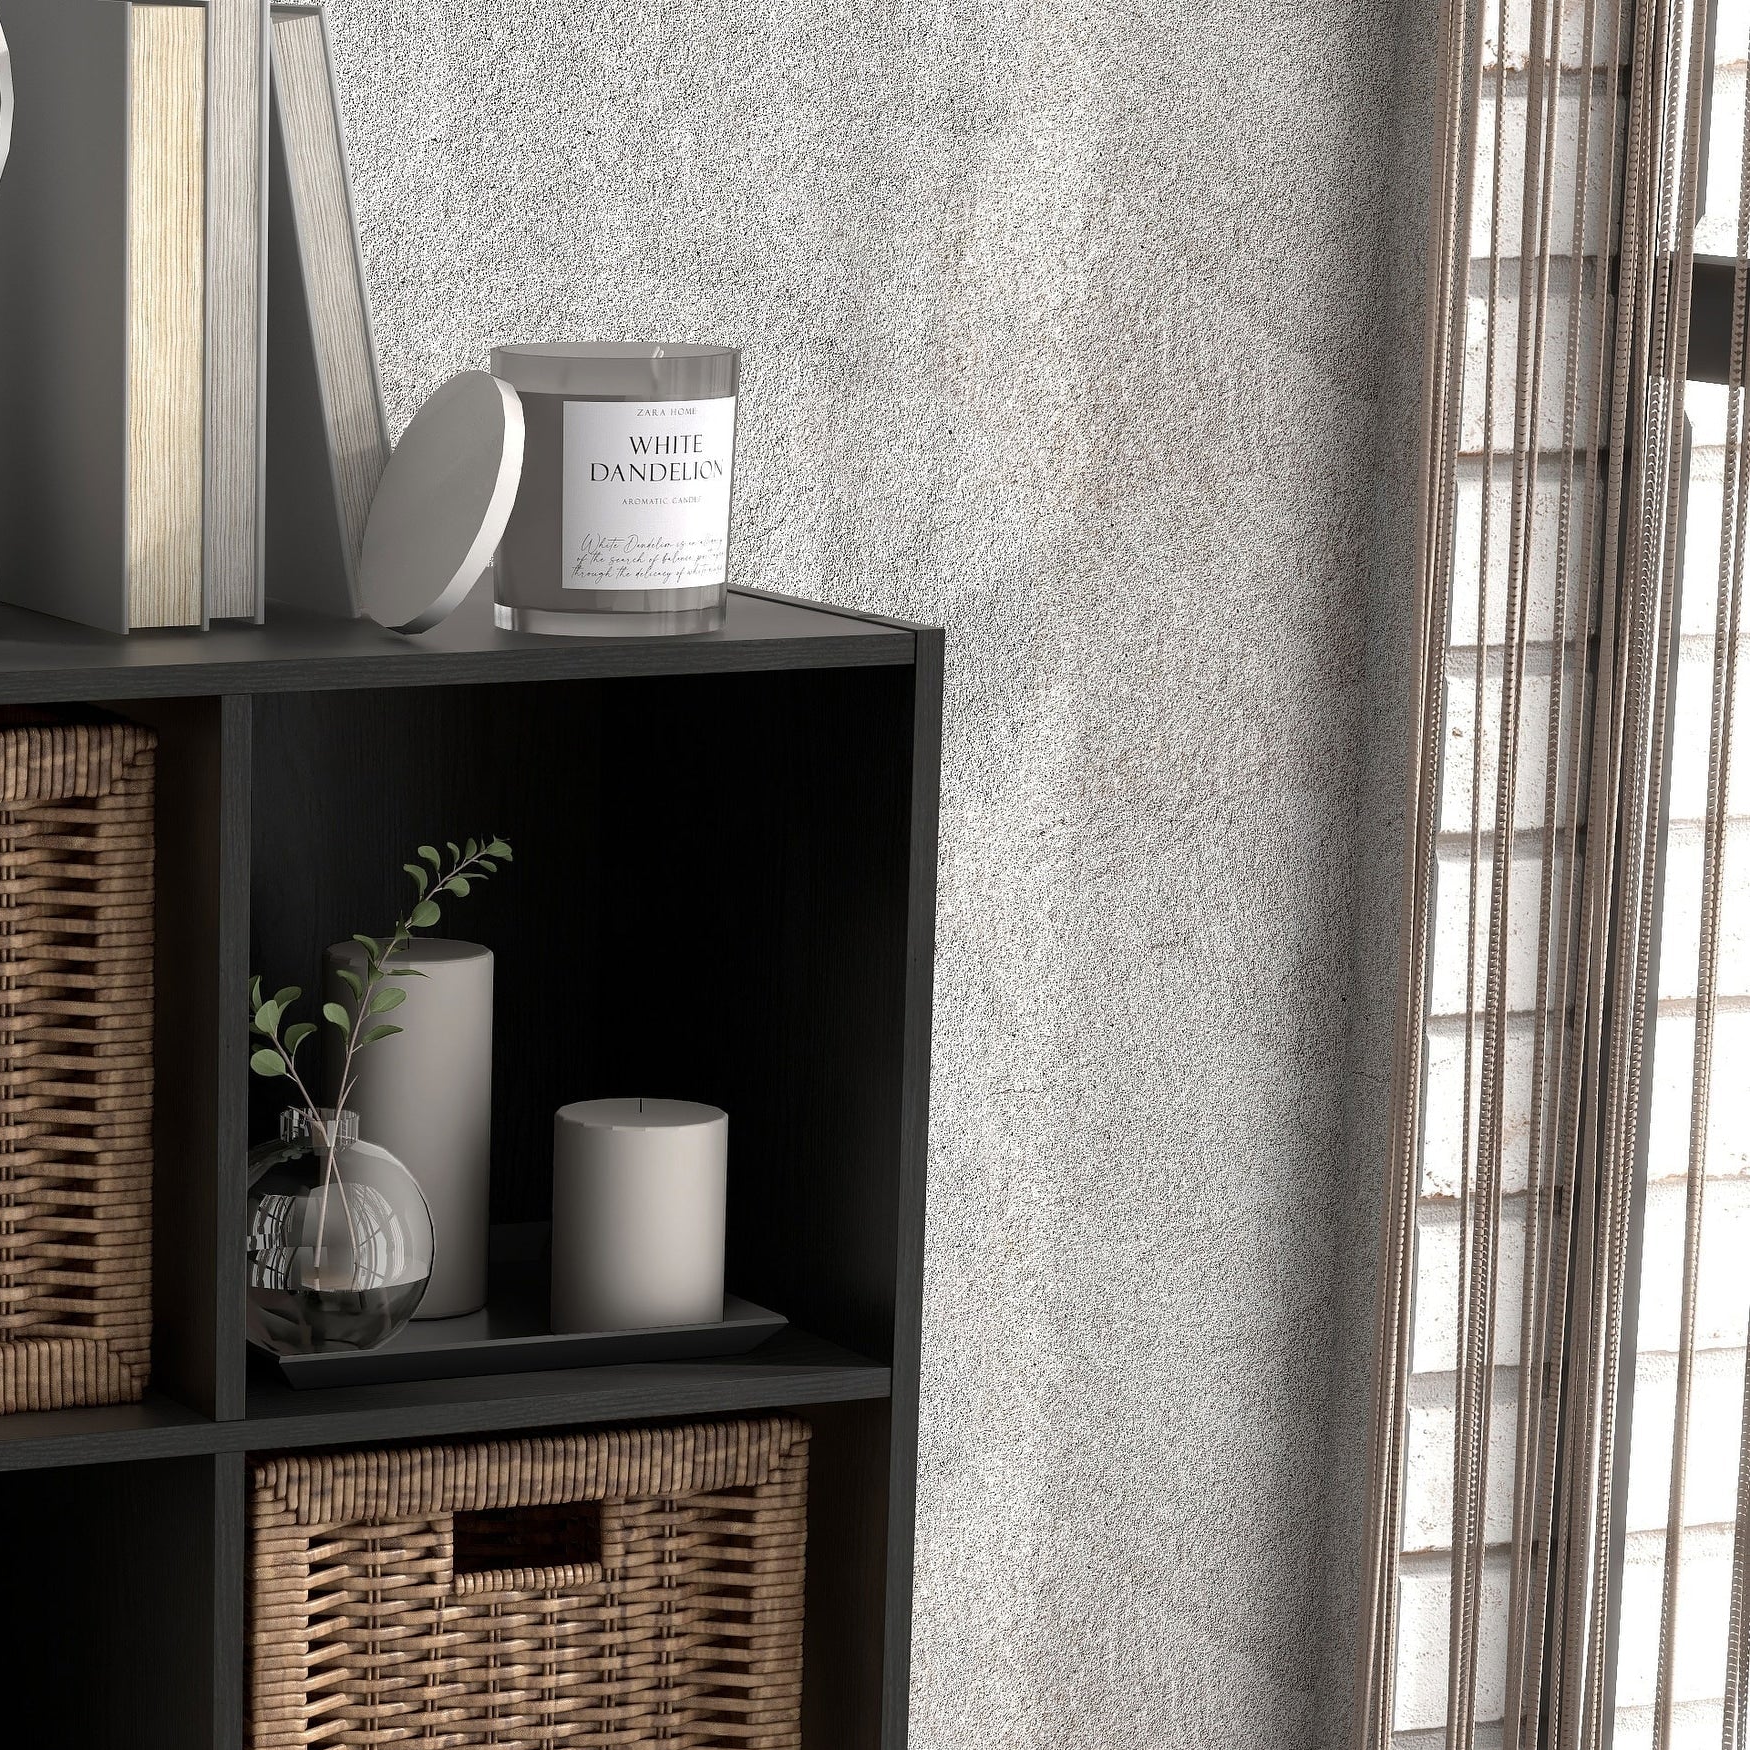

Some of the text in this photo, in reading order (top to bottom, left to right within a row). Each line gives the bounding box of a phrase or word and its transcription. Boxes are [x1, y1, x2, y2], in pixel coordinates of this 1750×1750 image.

[637, 407, 697, 417] ZARA HOME
[629, 434, 703, 455] WHITE
[590, 459, 724, 482] DANDELION
[622, 496, 668, 505] AROMATIC
[581, 533, 625, 554] White
[623, 534, 673, 554] Dandelion
[576, 553, 589, 568] of
[590, 551, 604, 564] the
[610, 551, 646, 565] search
[649, 552, 662, 568] of
[571, 564, 614, 585] through
[615, 565, 631, 578] the
[635, 566, 672, 584] delicacy
